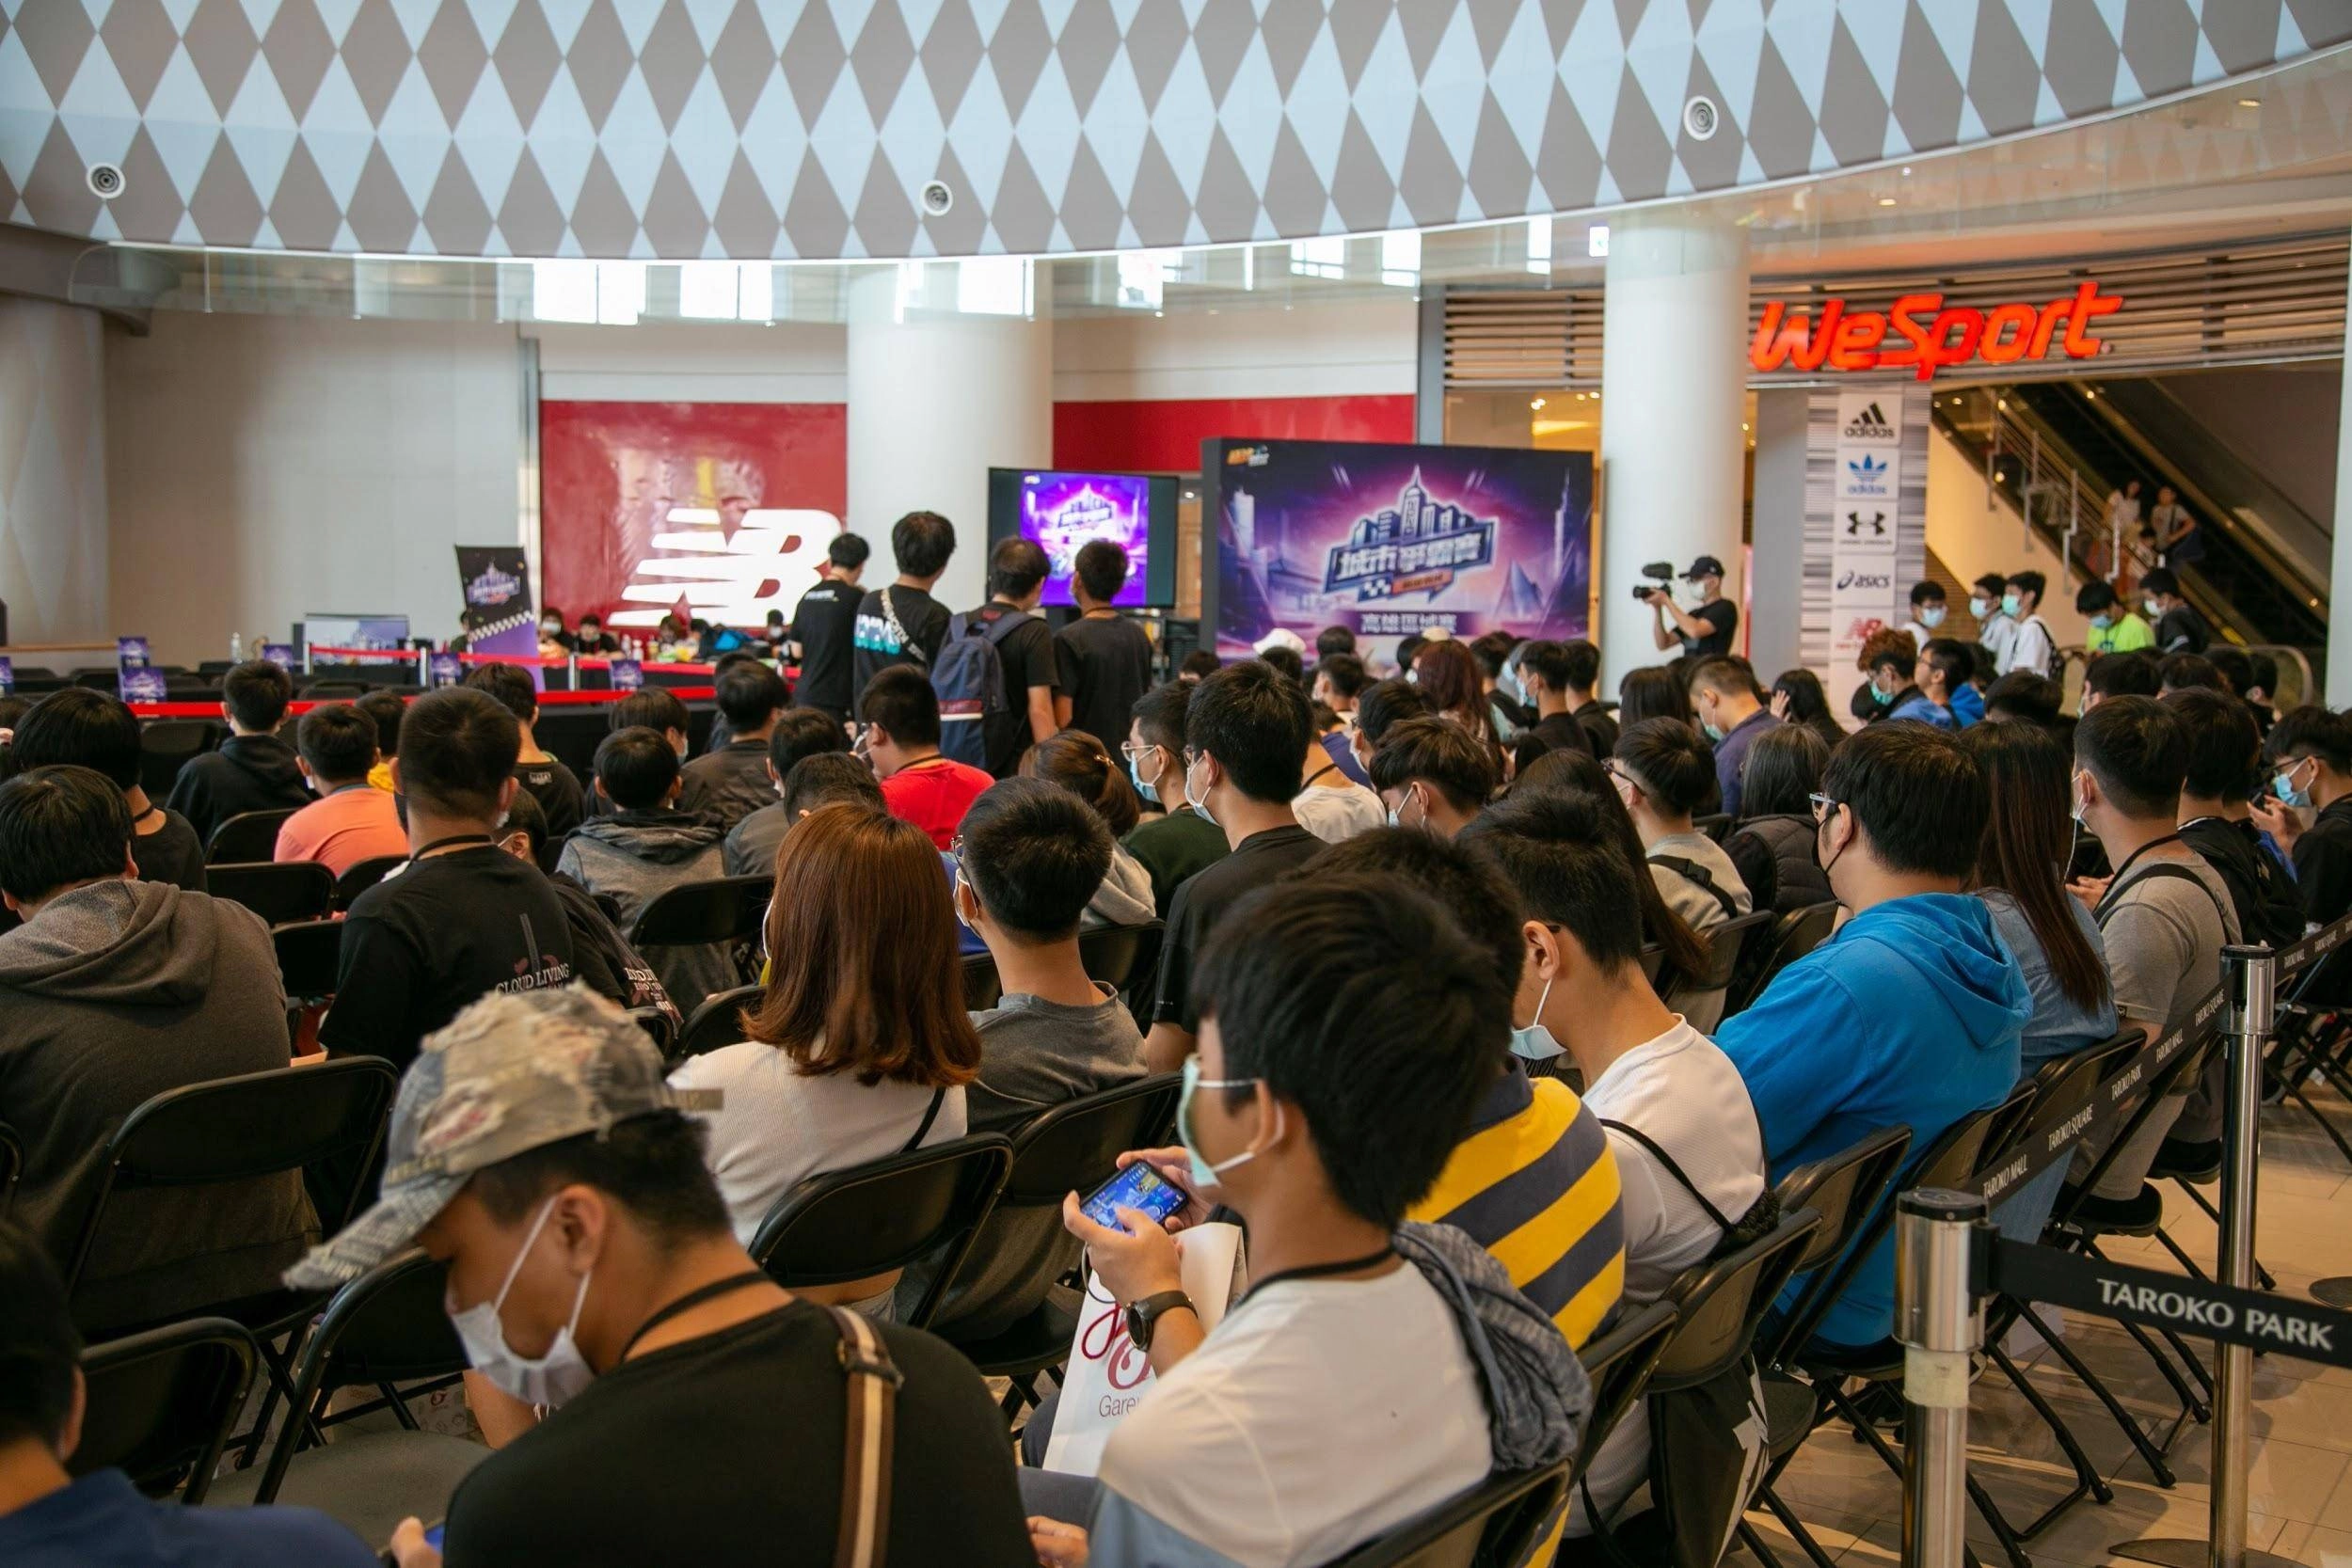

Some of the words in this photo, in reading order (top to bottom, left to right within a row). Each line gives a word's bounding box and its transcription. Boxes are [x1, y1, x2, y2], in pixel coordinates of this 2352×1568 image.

[1749, 281, 2123, 381] WeSport
[1844, 423, 1895, 438] adidas
[1854, 573, 1890, 589] asics
[535, 962, 570, 988] LIVING
[2048, 1120, 2072, 1151] TAROKO
[2071, 1103, 2093, 1134] SQUARE
[1983, 1166, 2010, 1198] TAROKO
[2010, 1153, 2028, 1181] MALL
[2096, 1277, 2235, 1328] TAROKO
[2244, 1307, 2335, 1352] PARK
[1099, 1395, 1140, 1418] Gare
